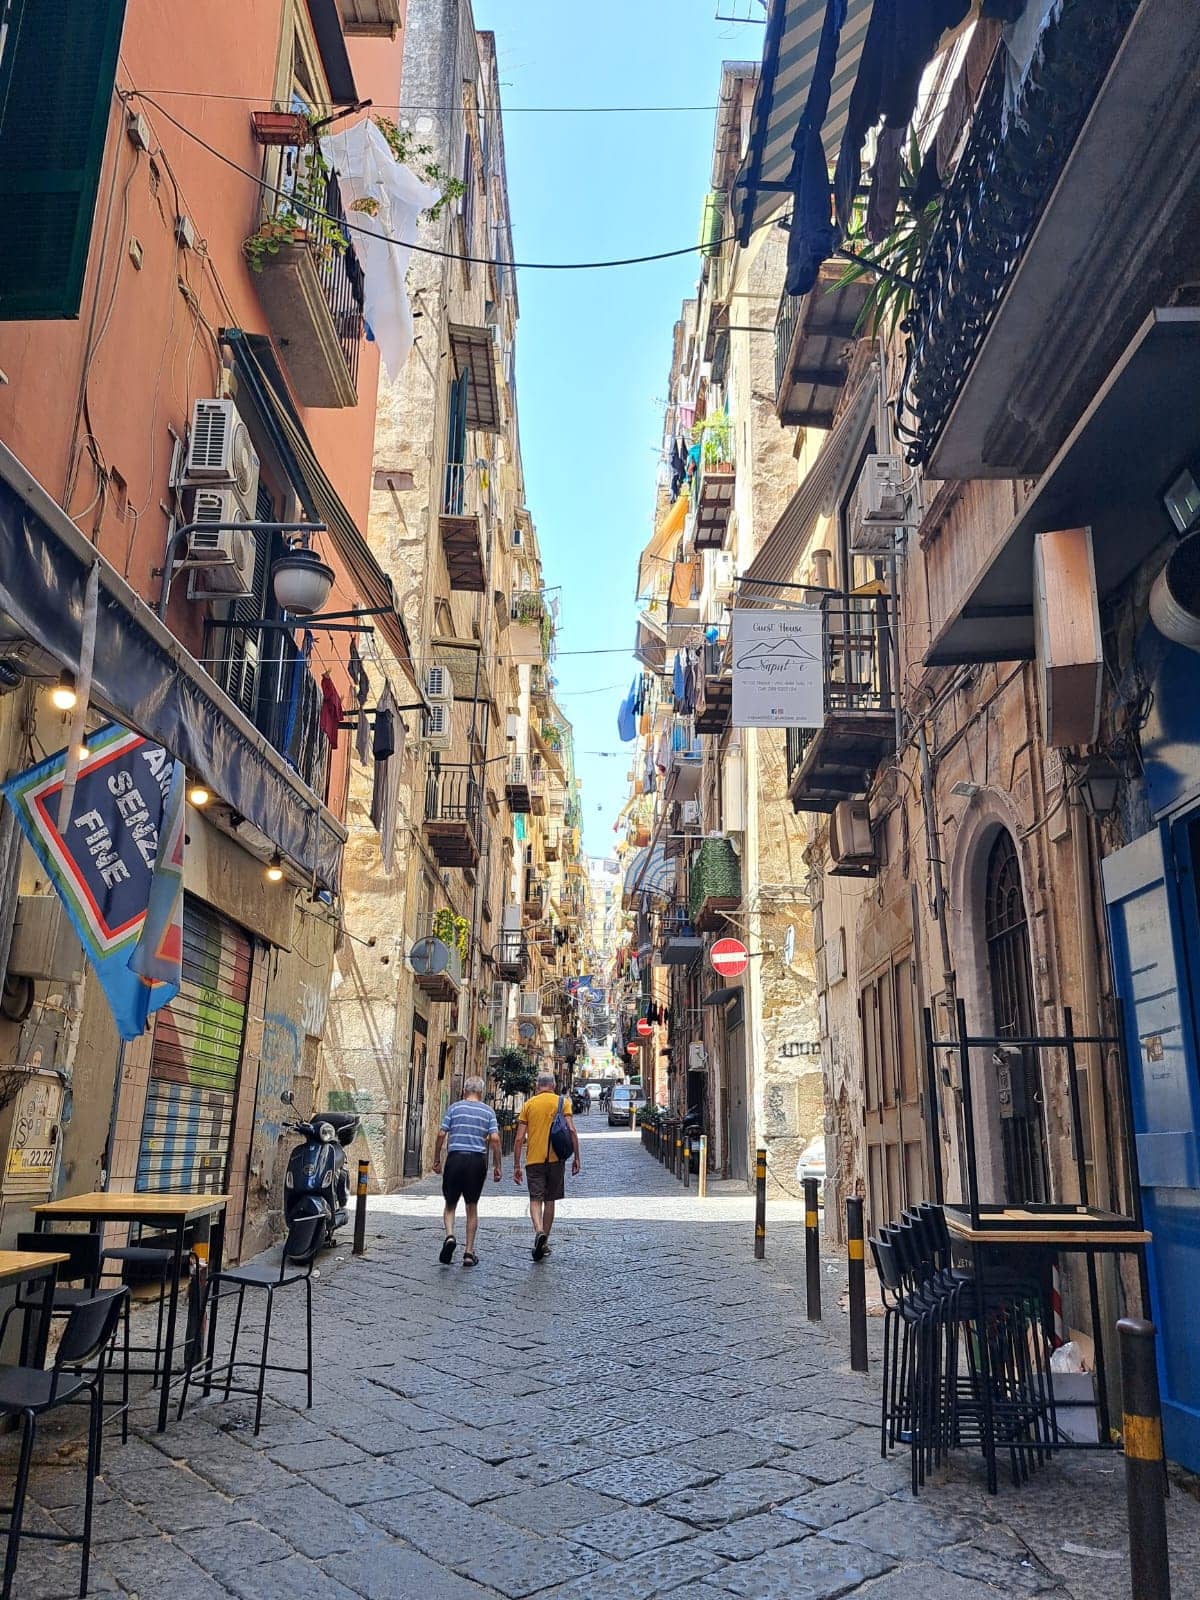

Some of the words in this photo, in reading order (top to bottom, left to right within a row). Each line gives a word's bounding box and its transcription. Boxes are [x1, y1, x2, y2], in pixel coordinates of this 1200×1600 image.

[752, 622, 775, 632] Guest
[778, 622, 802, 632] House
[73, 808, 132, 889] FINE
